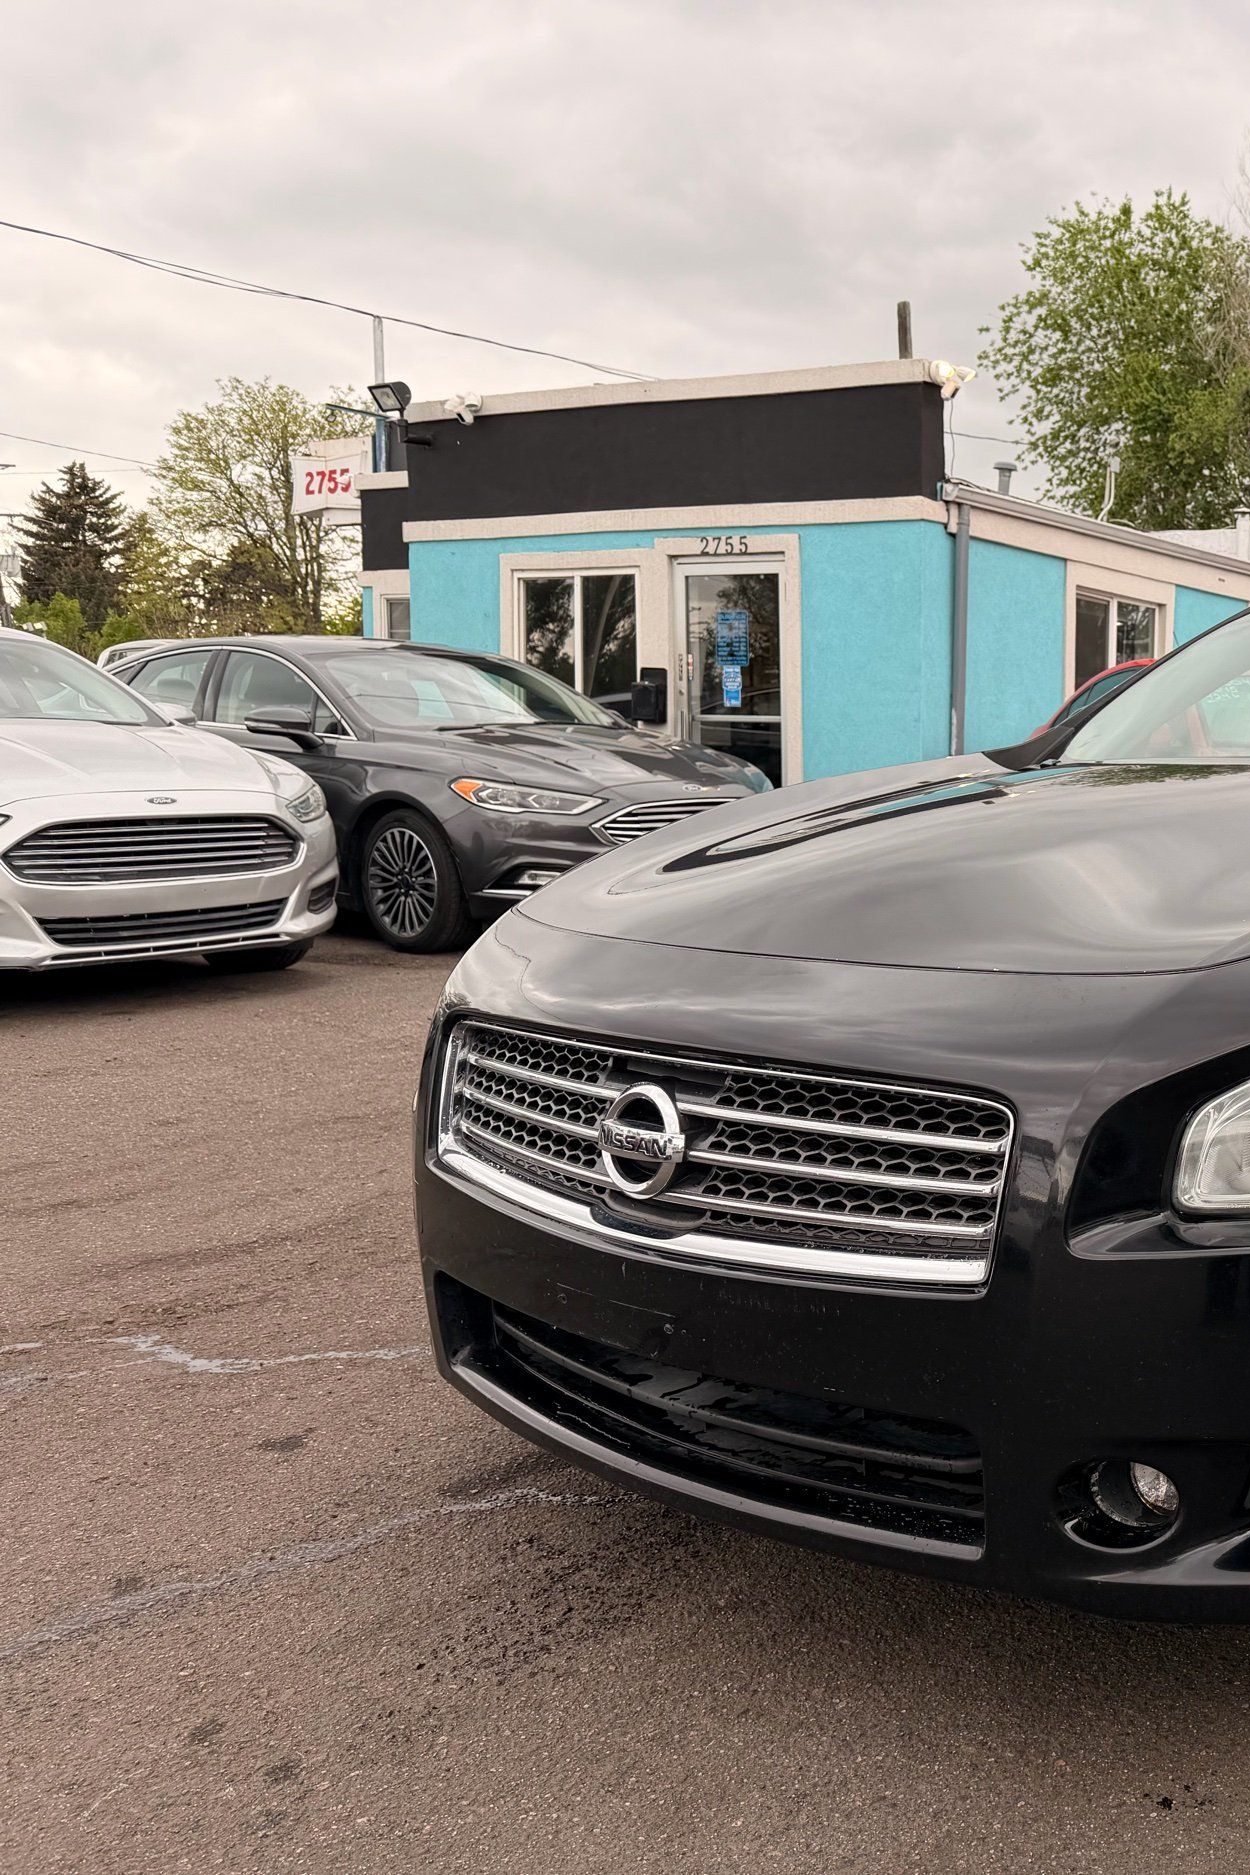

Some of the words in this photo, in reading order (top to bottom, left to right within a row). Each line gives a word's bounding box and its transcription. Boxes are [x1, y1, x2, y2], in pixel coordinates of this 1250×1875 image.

[305, 468, 351, 495] 2755
[700, 536, 748, 555] 2755
[600, 1123, 671, 1160] NISSAN
